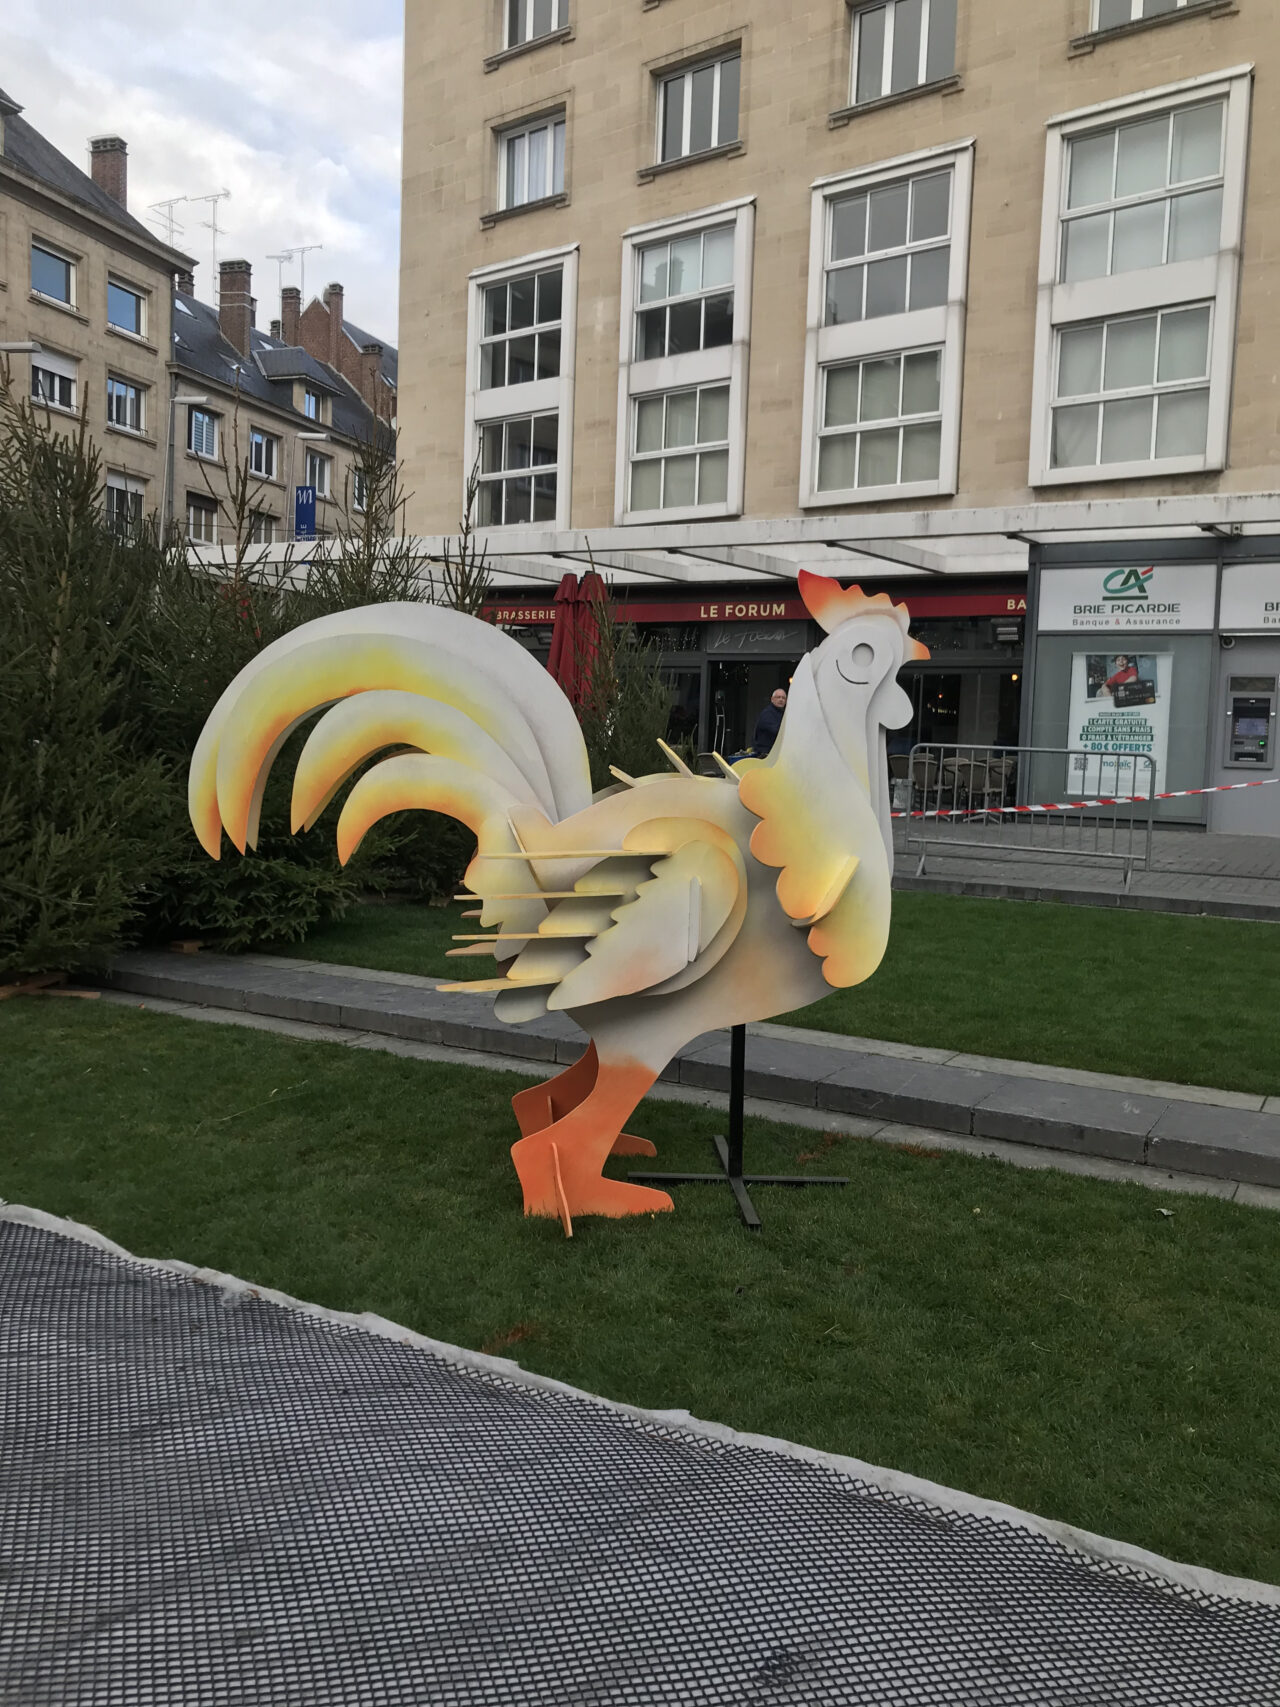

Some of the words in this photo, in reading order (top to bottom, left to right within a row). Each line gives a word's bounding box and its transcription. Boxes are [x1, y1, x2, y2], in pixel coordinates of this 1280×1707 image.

[700, 605, 719, 618] LE
[725, 603, 785, 617] FORUM
[1073, 604, 1106, 614] BRIE
[1111, 603, 1181, 614] PICARDIE
[496, 610, 556, 620] BRASSERIE
[1072, 618, 1110, 627] Banque
[1111, 743, 1153, 752] OFFERTS
